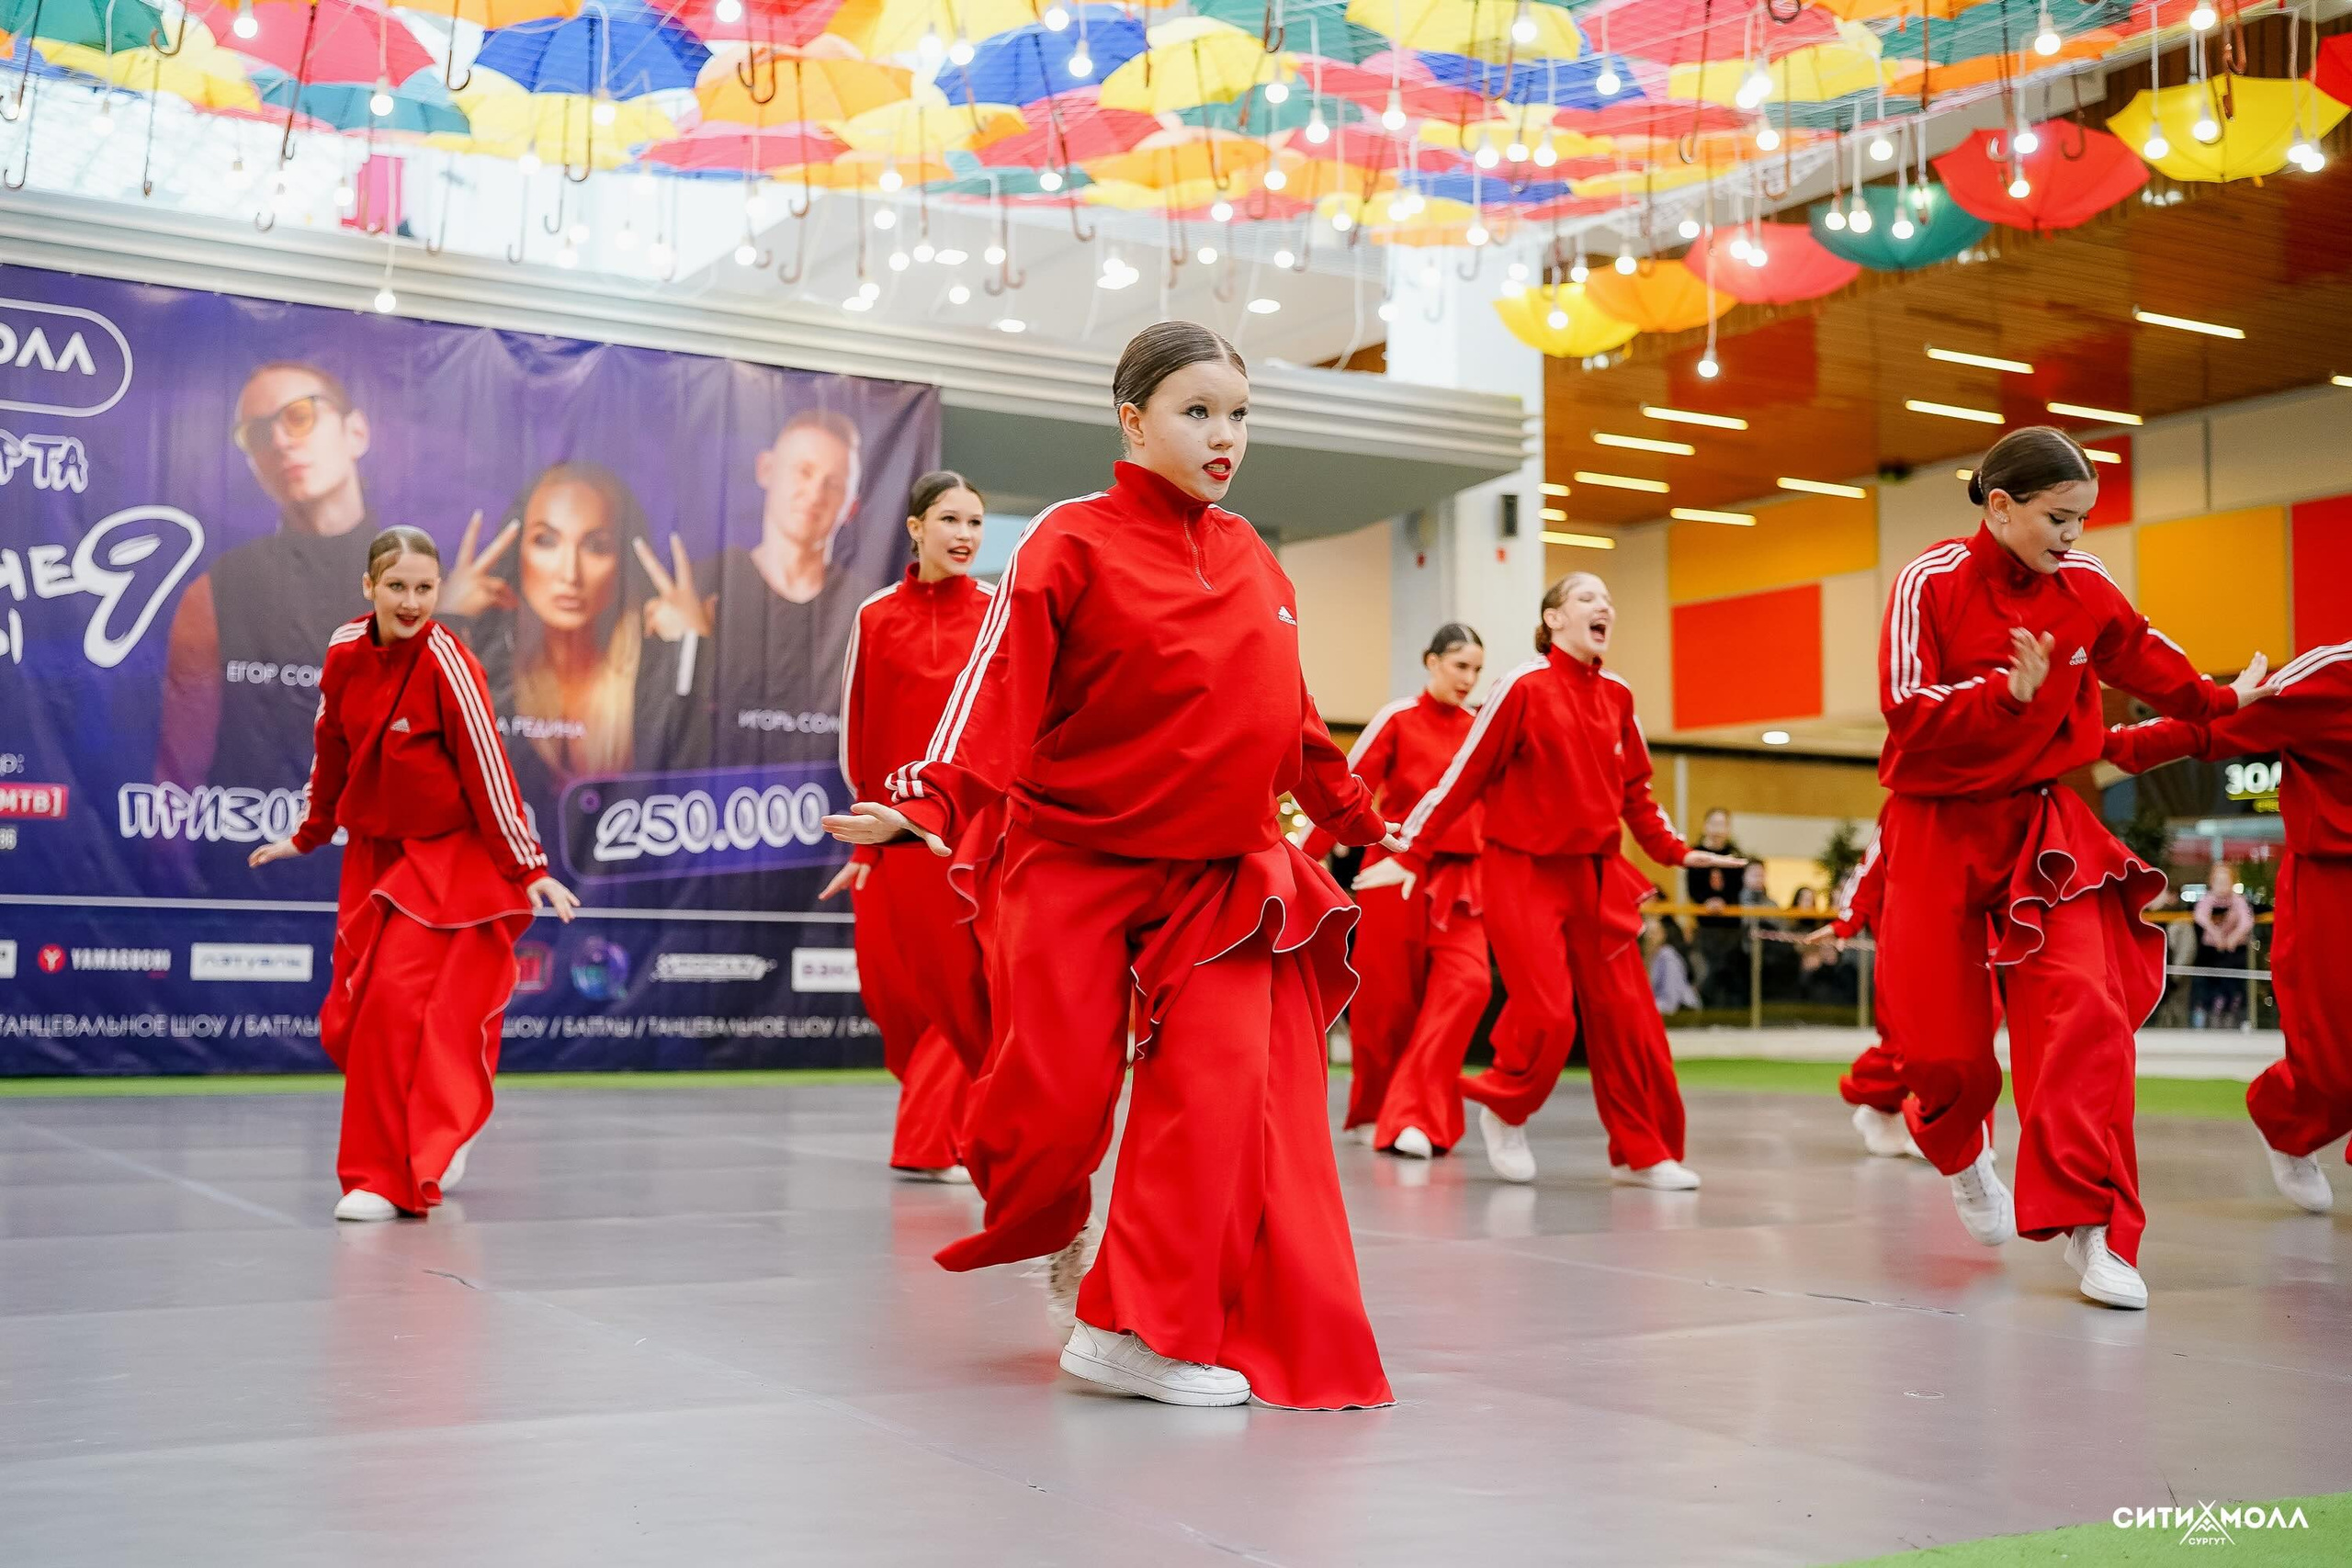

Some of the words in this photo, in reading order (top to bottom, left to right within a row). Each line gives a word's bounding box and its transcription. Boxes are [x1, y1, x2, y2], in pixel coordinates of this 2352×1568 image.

[226, 660, 279, 684] ЕГОР
[594, 782, 830, 862] 250.000
[171, 1014, 227, 1038] ШОУ
